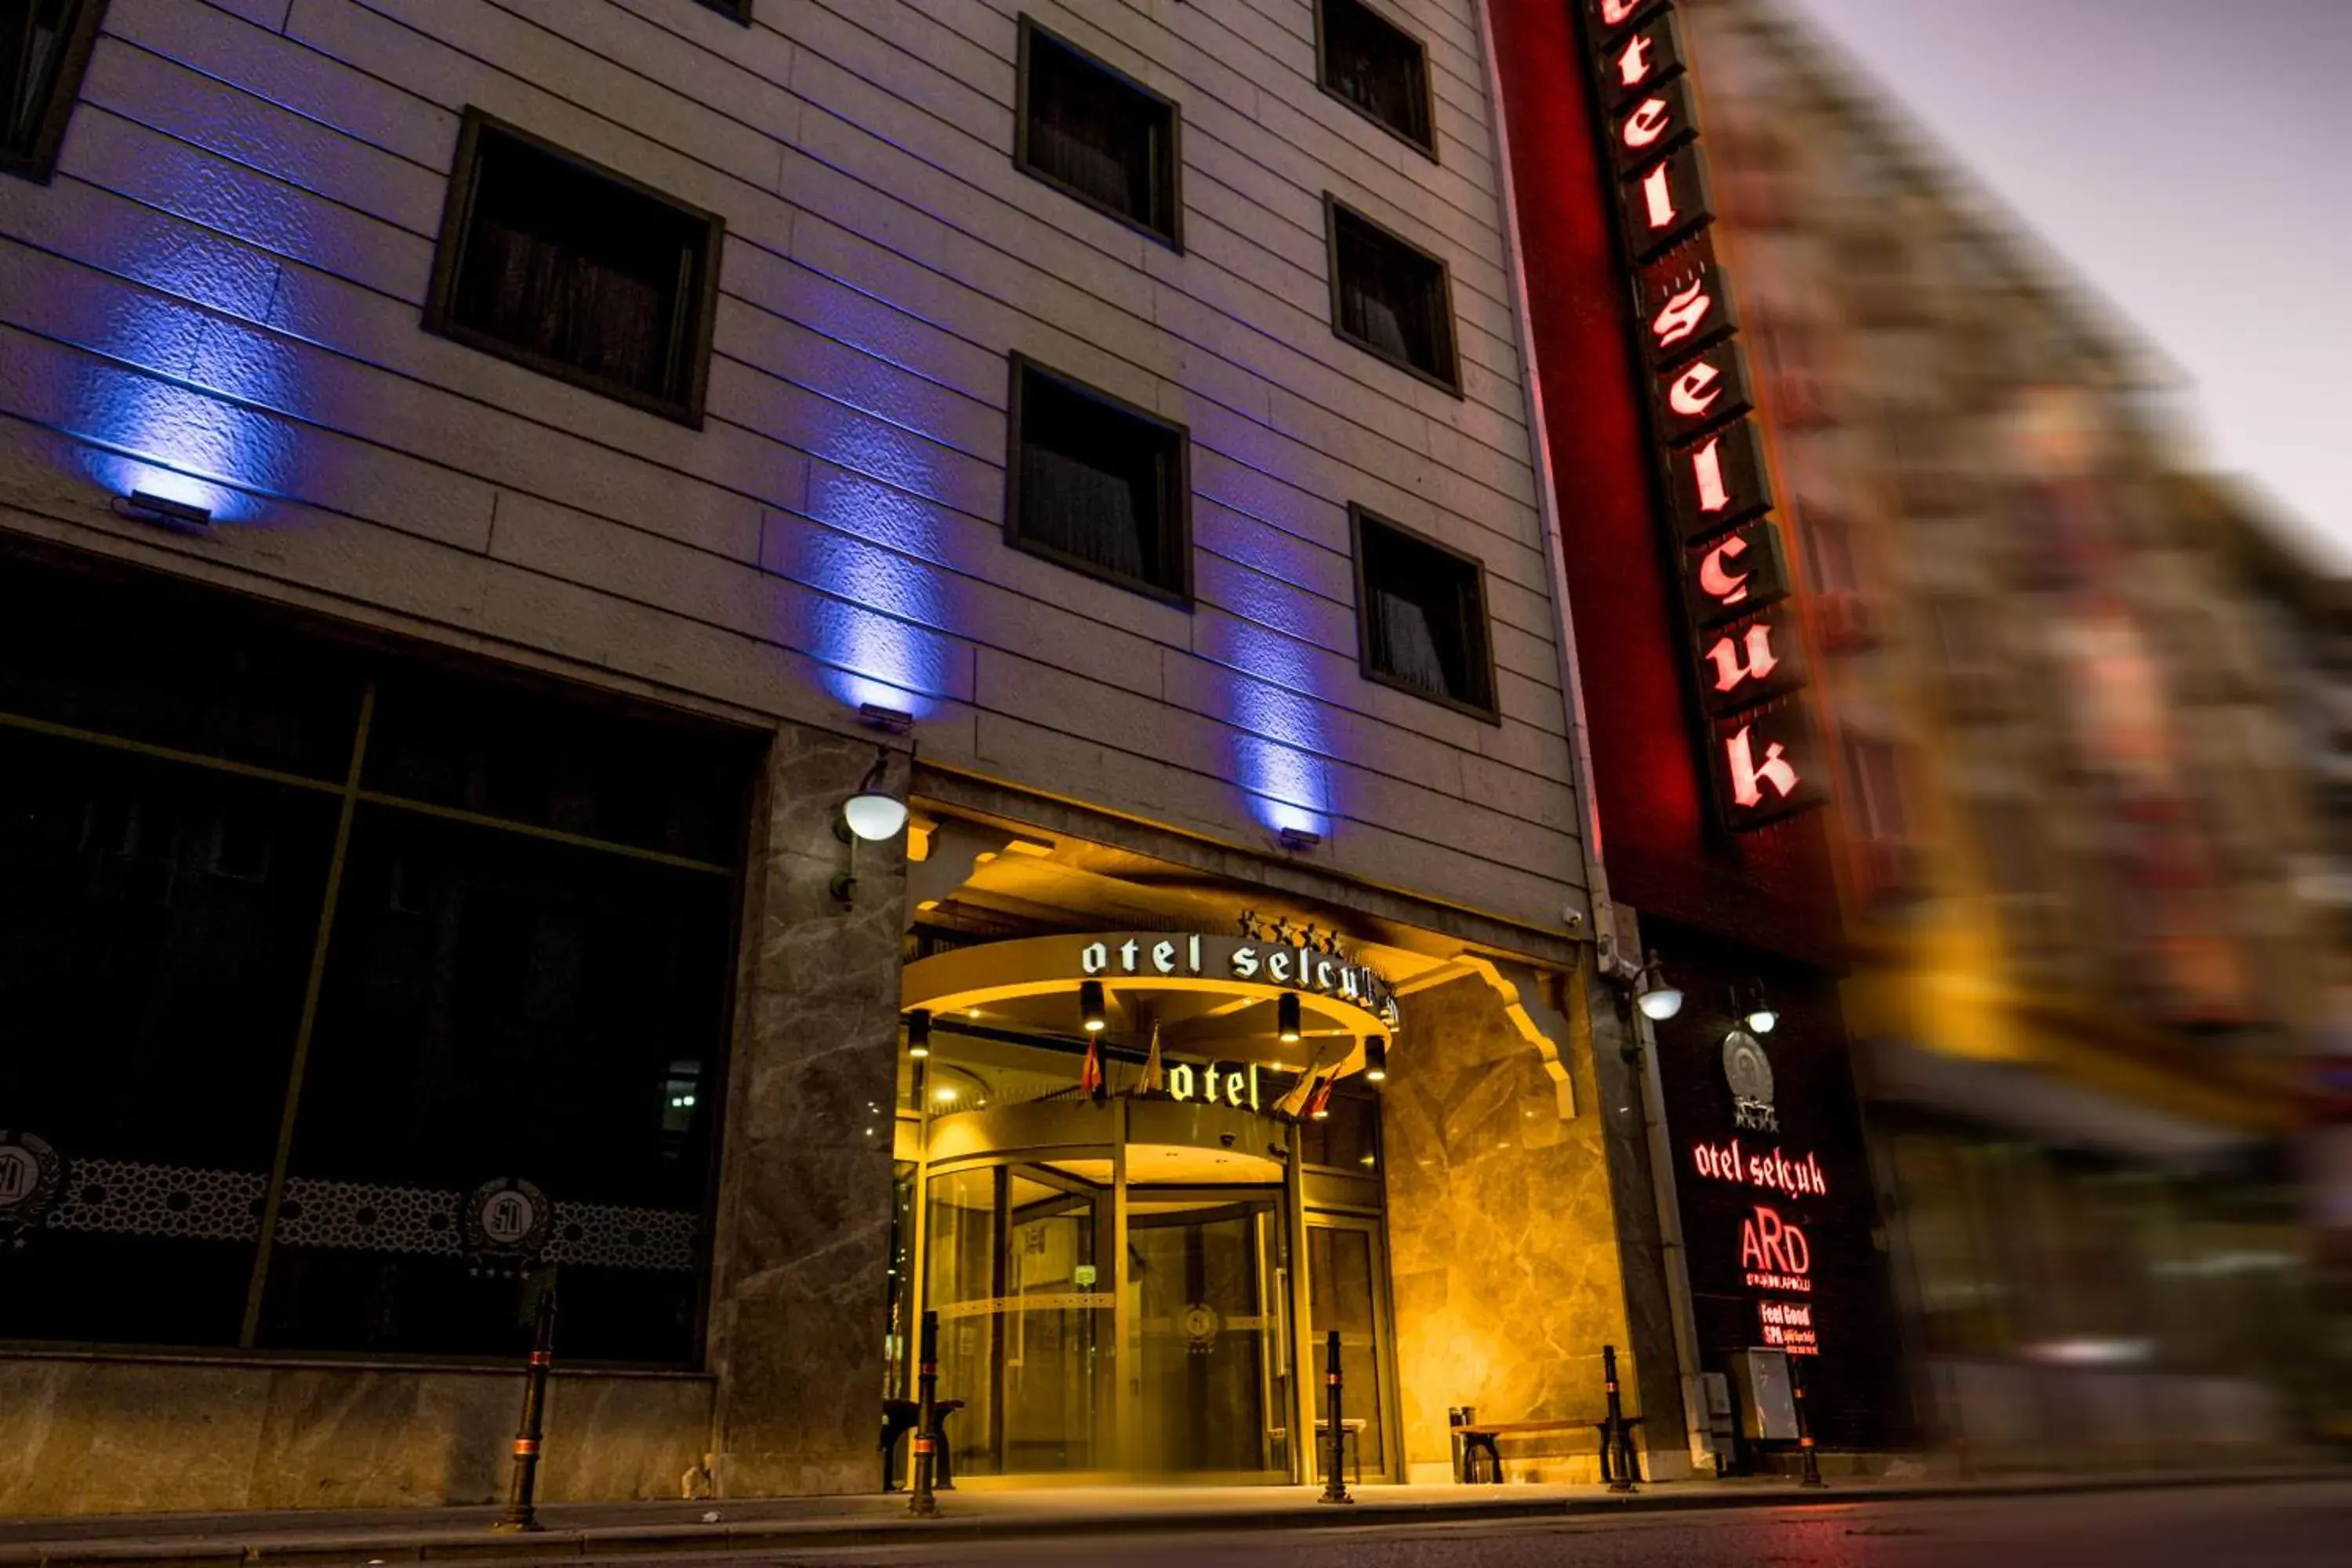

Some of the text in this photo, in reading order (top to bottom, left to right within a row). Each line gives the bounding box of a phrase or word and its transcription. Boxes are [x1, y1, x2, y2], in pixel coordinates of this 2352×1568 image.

[1082, 934, 1200, 974] otel
[1169, 1062, 1259, 1112] otel
[1694, 1139, 1743, 1182] otel
[1742, 1206, 1809, 1274] ARD
